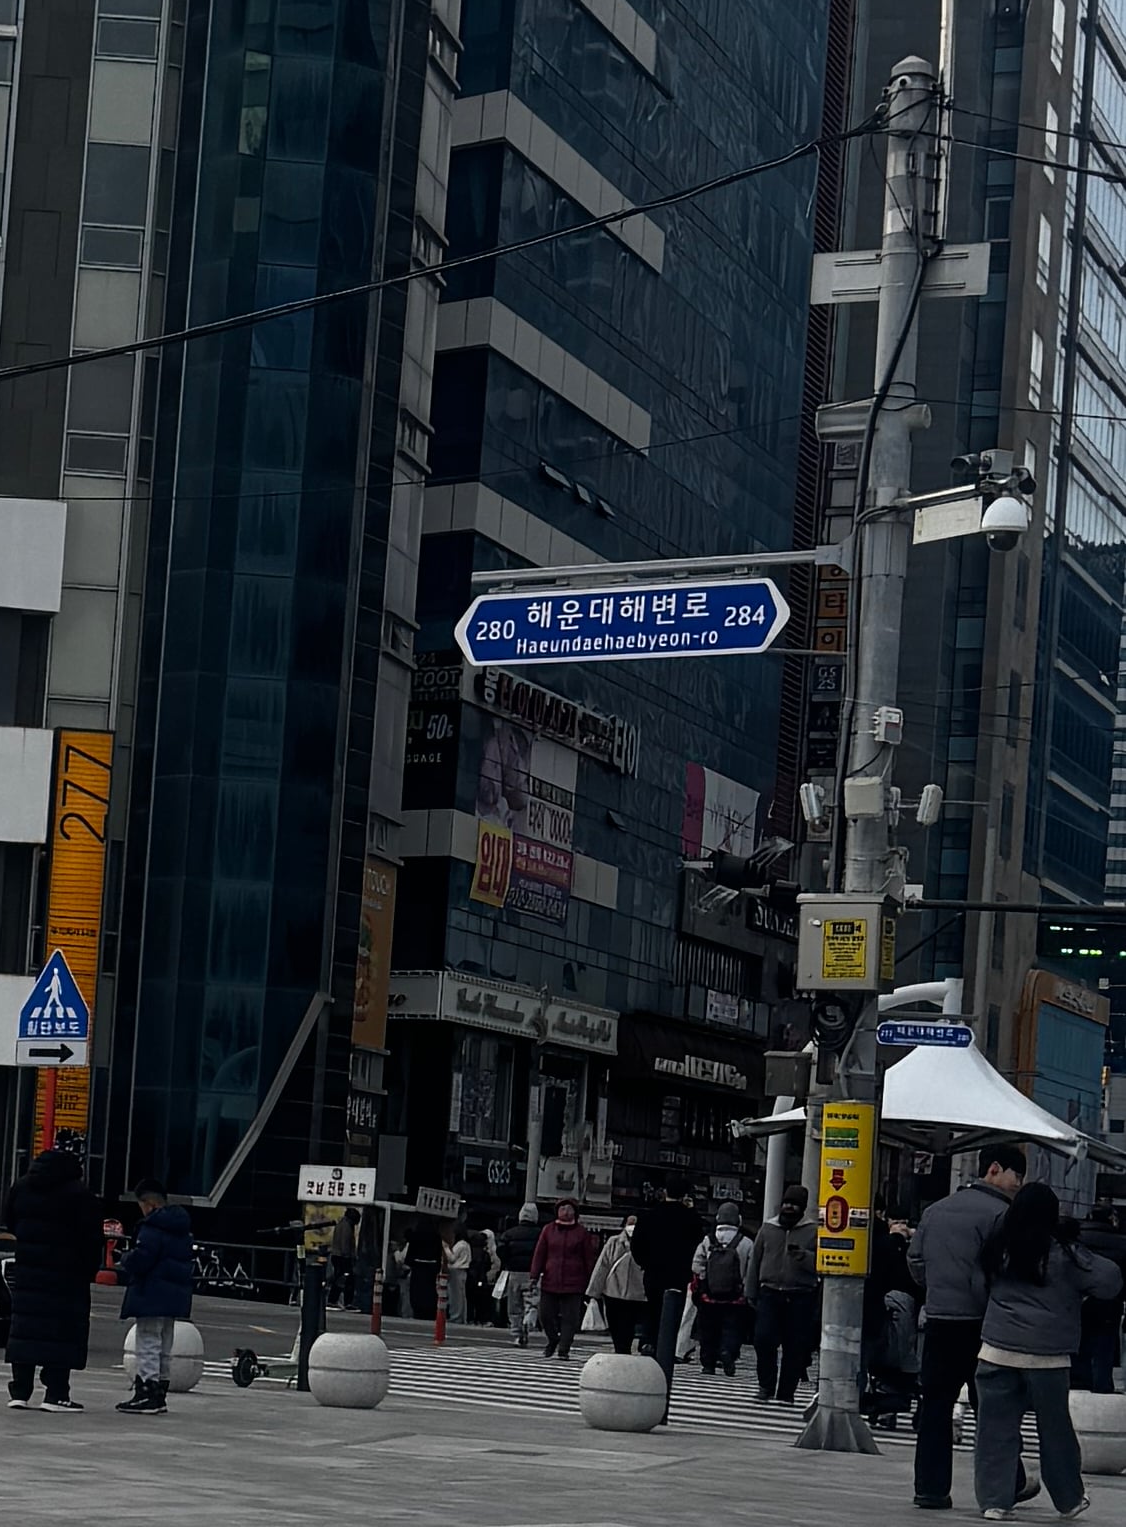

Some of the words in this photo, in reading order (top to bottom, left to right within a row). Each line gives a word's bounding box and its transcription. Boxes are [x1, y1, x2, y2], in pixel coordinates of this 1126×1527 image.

[476, 619, 516, 641] 280
[527, 592, 711, 631] 해운대해변로
[723, 604, 766, 627] 284
[516, 630, 719, 656] Haeundaehaebyeon-ro
[59, 743, 114, 845] 277
